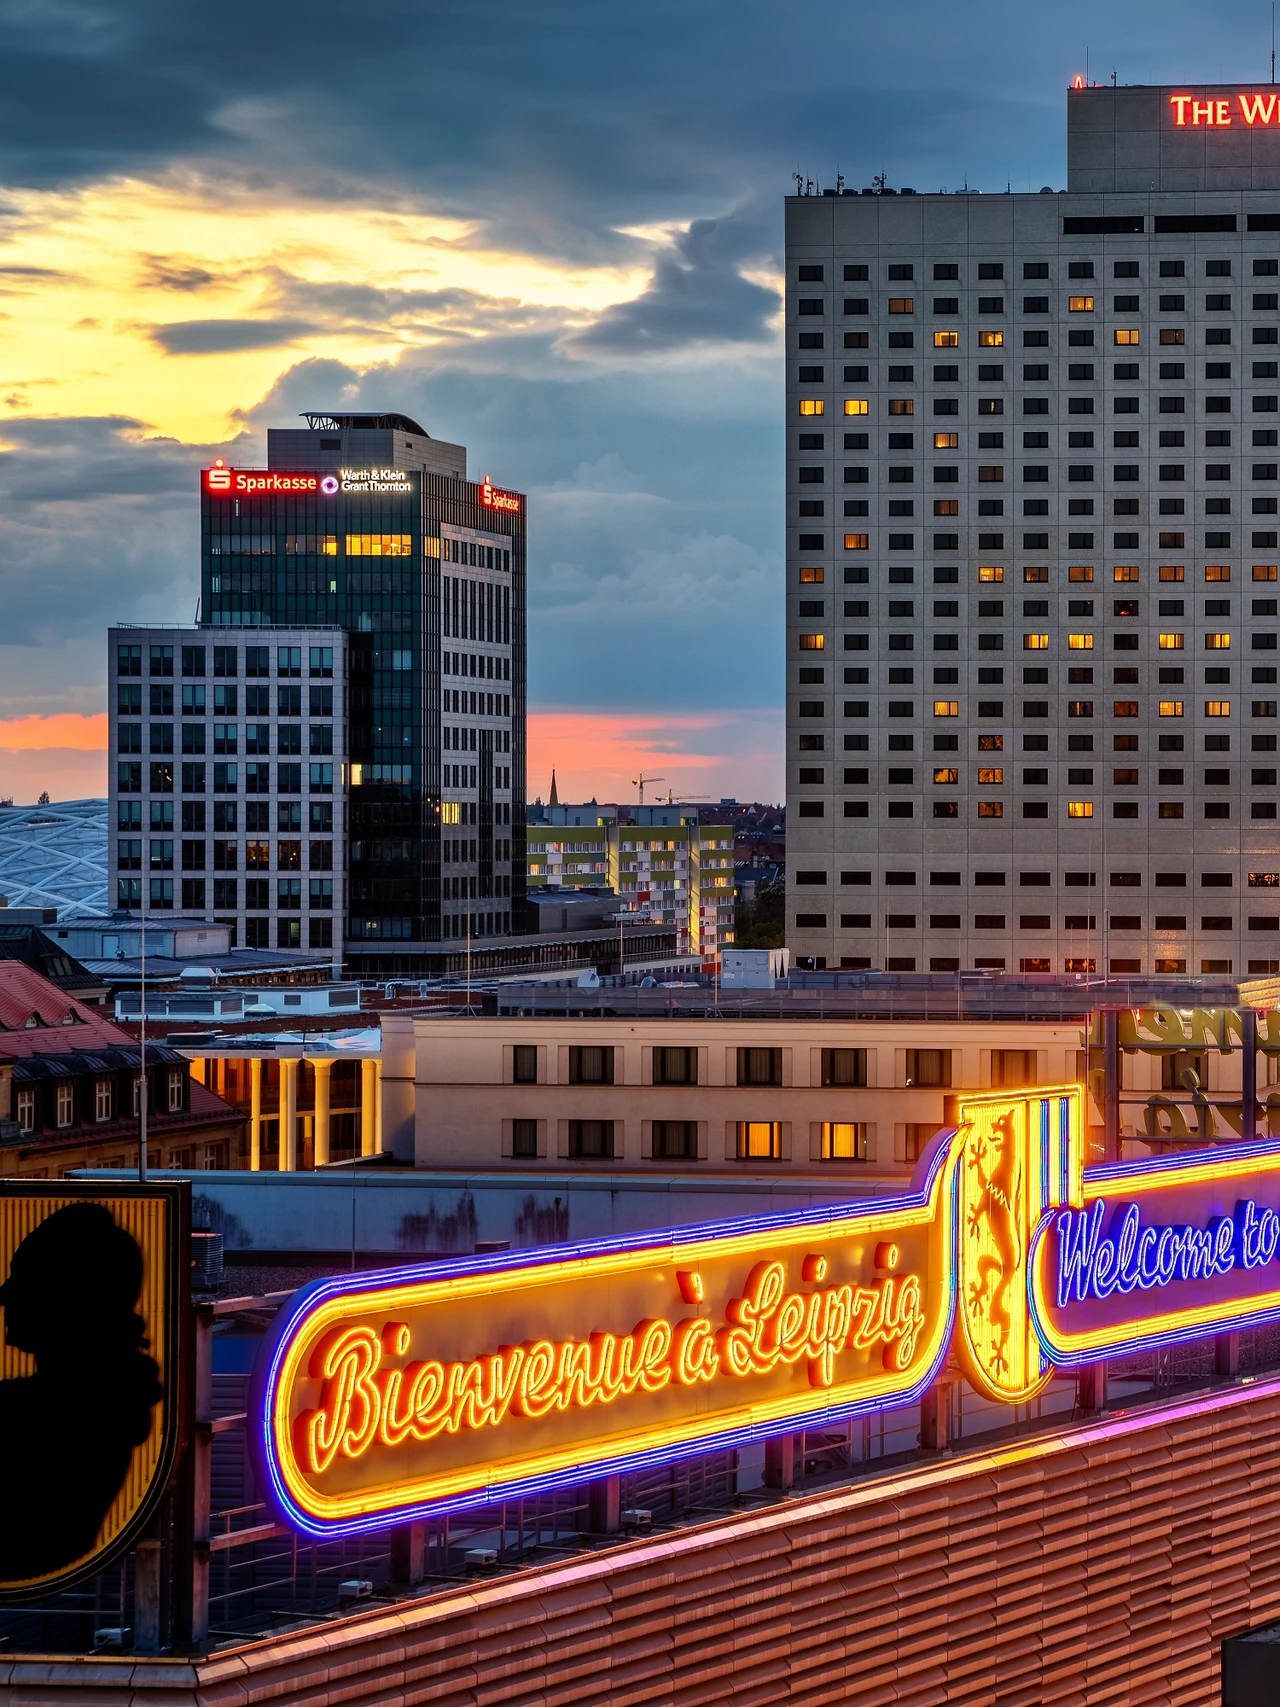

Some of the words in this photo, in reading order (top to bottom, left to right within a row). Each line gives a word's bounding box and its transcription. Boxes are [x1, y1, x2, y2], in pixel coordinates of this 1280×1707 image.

[1170, 96, 1232, 126] THE
[236, 474, 317, 492] Sparkasse
[341, 469, 370, 480] Warth
[371, 470, 379, 480] &
[380, 469, 405, 480] Klein
[492, 492, 519, 511] Sparkasse
[1057, 1197, 1236, 1308] Welcome
[1240, 1199, 1278, 1271] to
[300, 1322, 673, 1474] Bienvenue
[675, 1271, 719, 1386] à
[727, 1241, 925, 1387] Leipzig
